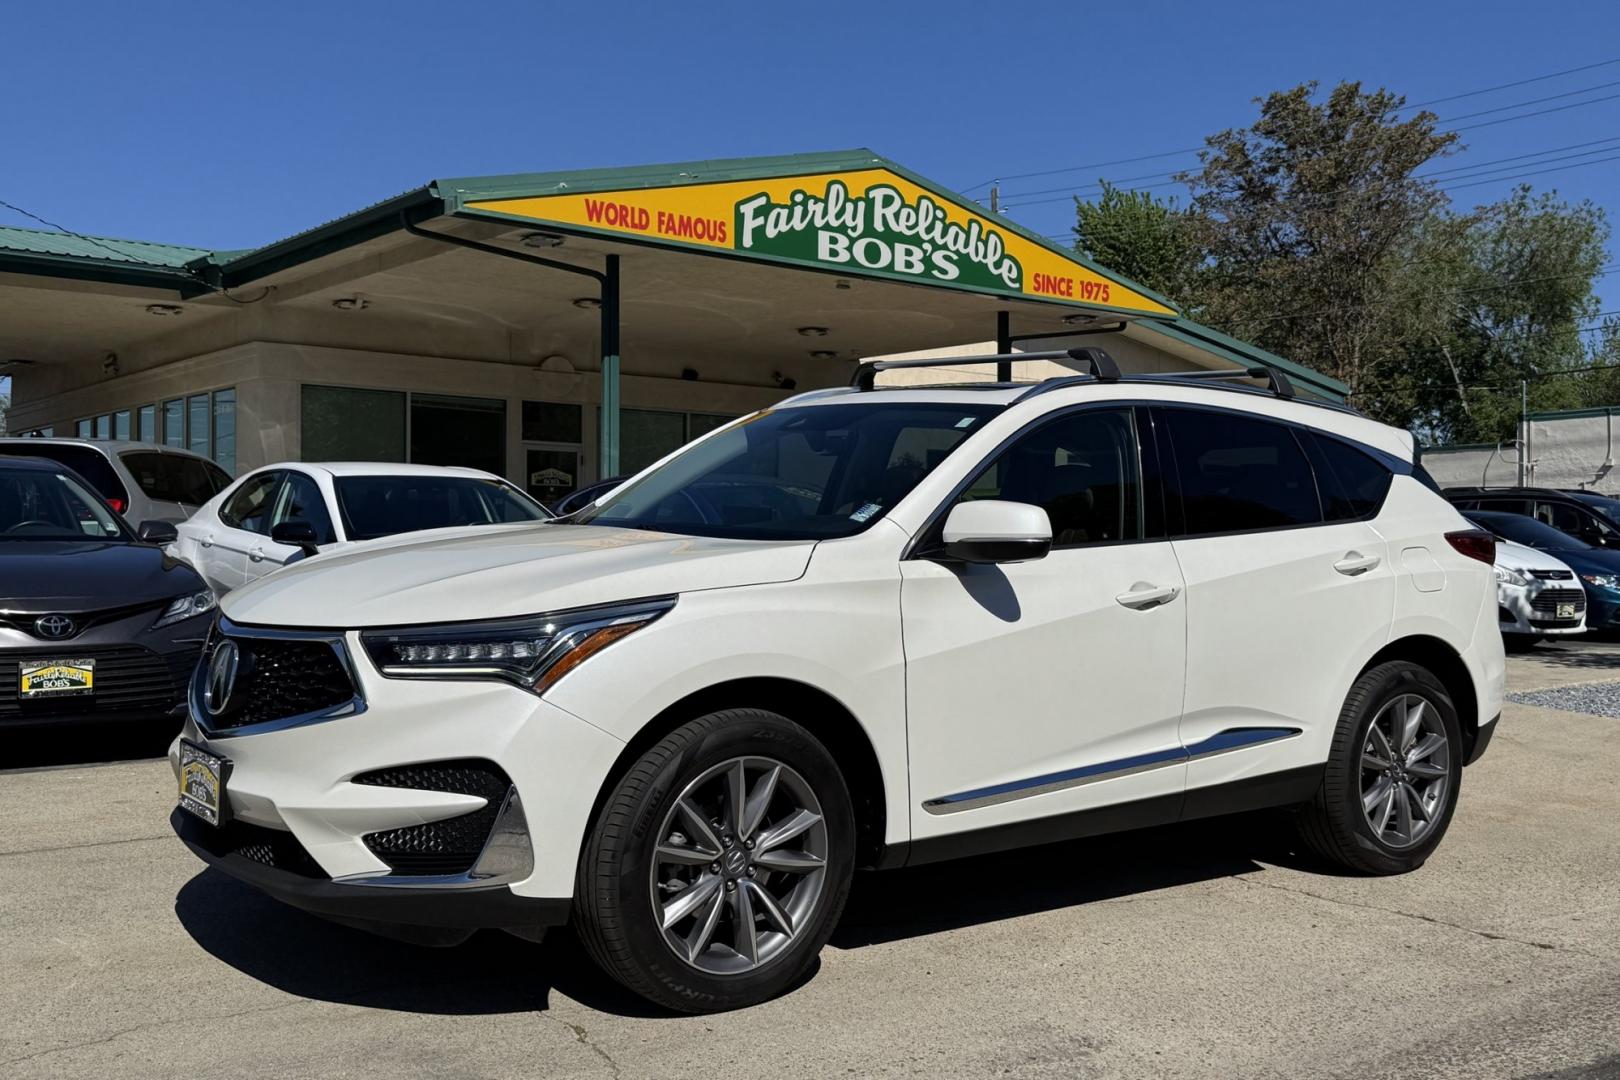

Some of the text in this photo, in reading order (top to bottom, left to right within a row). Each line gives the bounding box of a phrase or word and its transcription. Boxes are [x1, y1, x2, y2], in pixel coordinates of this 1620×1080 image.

[584, 198, 727, 243] WORLD FAMOUS
[740, 183, 1020, 288] Fairly Reliable
[818, 230, 960, 280] BOB'S
[1033, 272, 1109, 302] SINCE 1975
